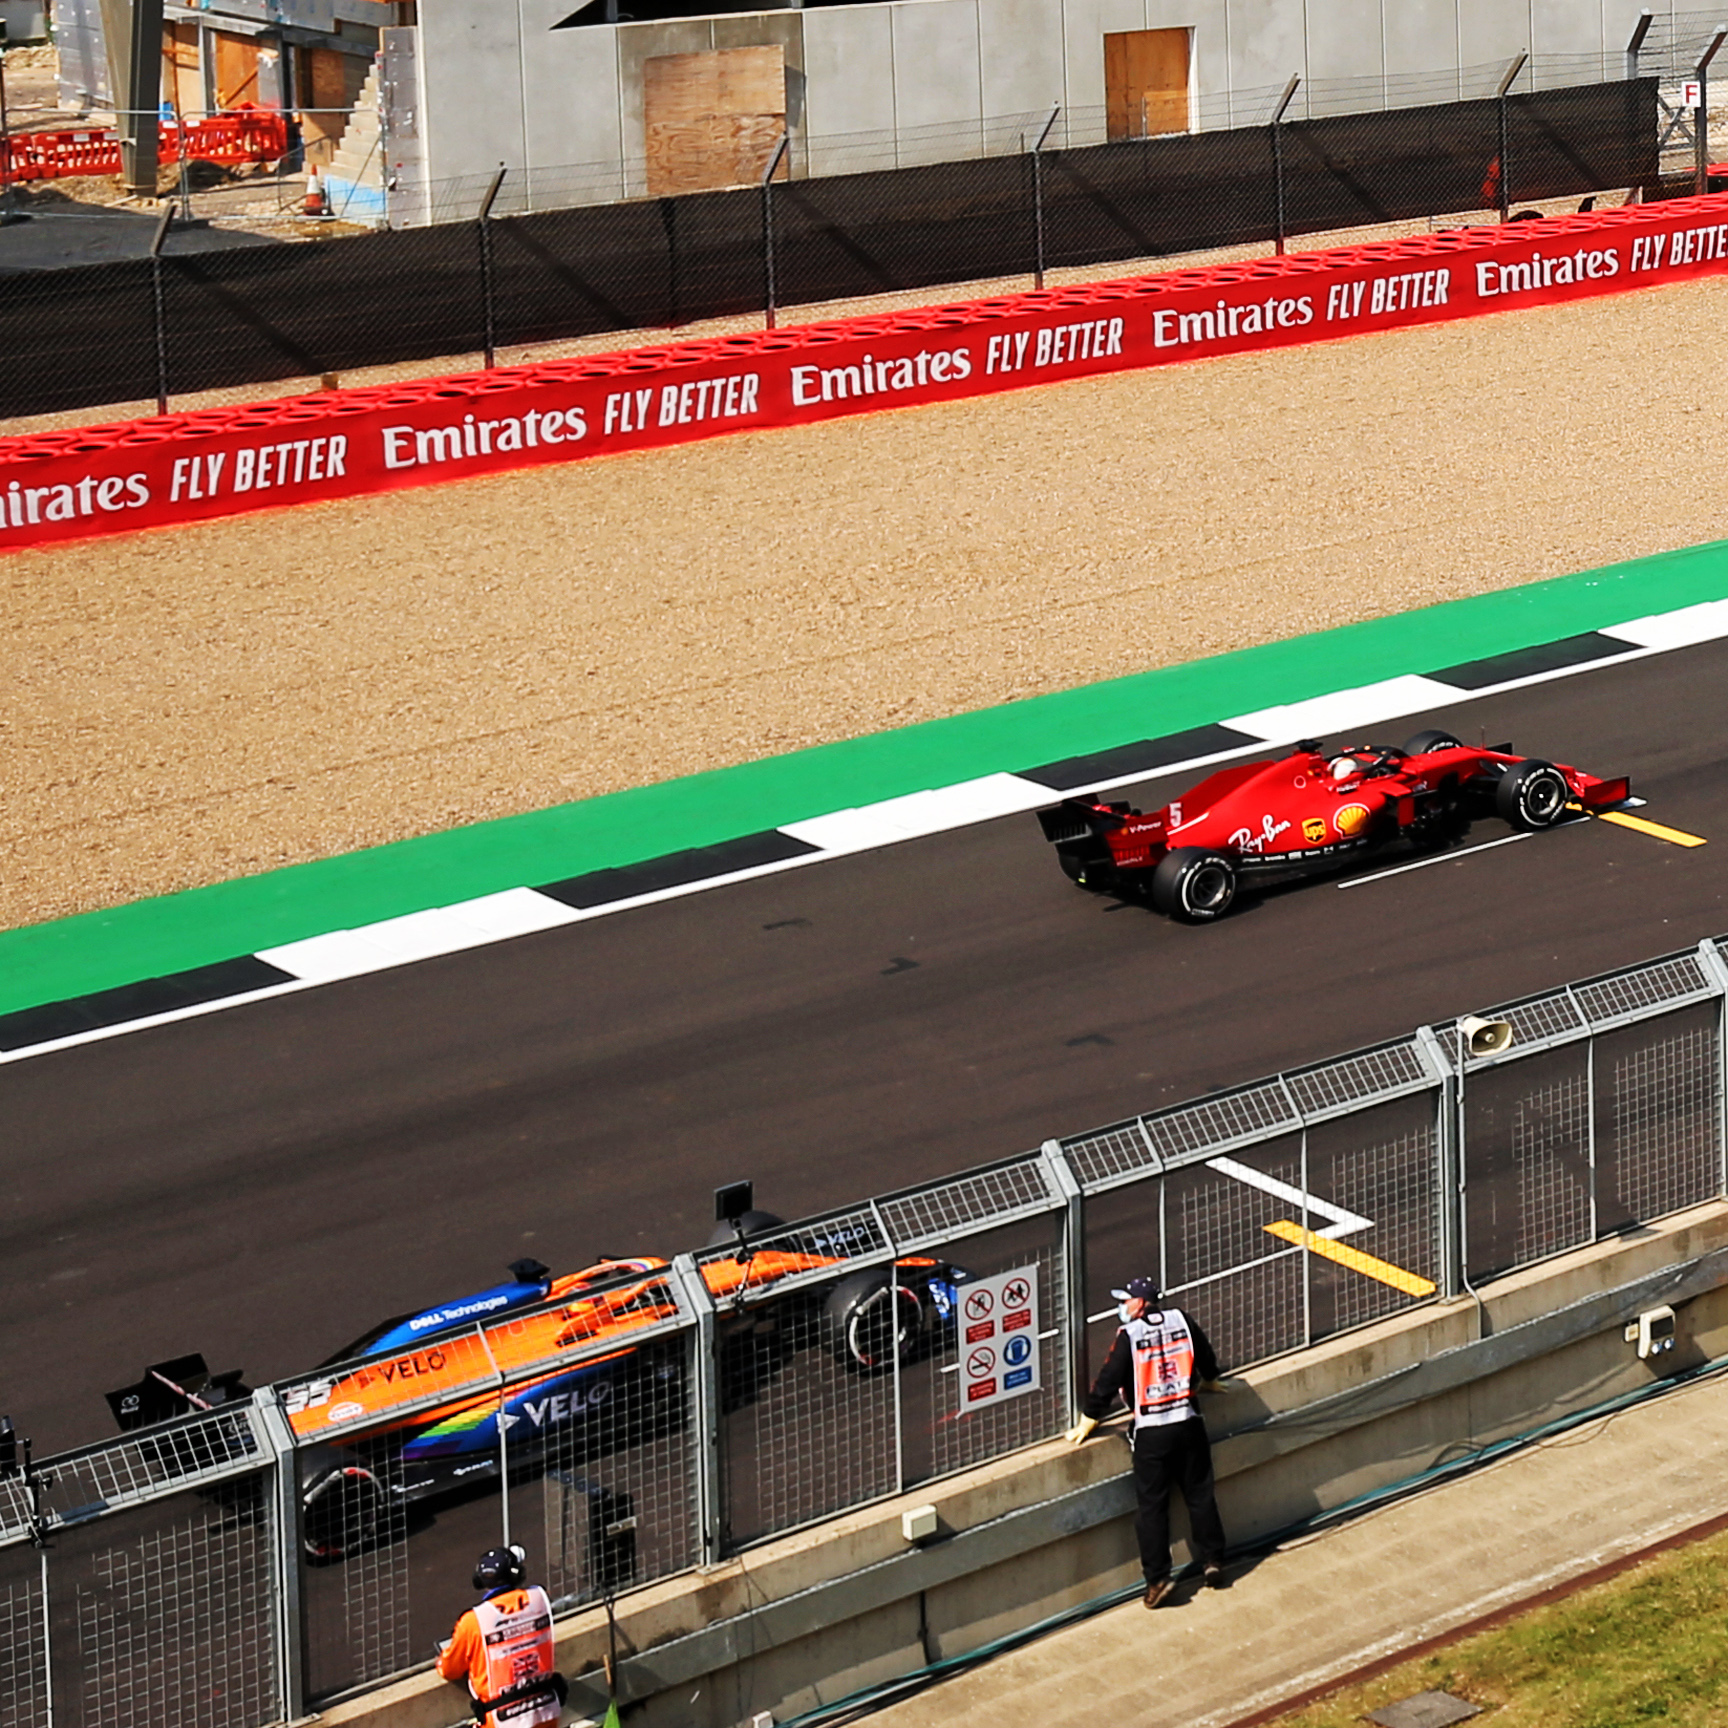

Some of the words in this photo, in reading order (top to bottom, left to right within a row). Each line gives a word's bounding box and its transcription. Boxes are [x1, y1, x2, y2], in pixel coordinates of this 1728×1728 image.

[1685, 85, 1698, 105] F
[1475, 248, 1619, 297] Emirates
[1631, 233, 1666, 272] FLY
[1153, 296, 1314, 351] Emirates
[1326, 280, 1366, 321] FLY
[1370, 268, 1450, 315] BETTER
[790, 346, 972, 406] Emirates
[986, 331, 1029, 375] FLY
[1034, 317, 1123, 367] BETTER
[382, 407, 587, 472] Emirates
[604, 388, 653, 435] FLY
[658, 373, 759, 427] BETTER
[170, 452, 226, 502] FLY
[233, 435, 347, 492] BETTER
[1169, 802, 1182, 827] 5
[443, 1295, 508, 1319] Technologies
[378, 1351, 446, 1385] VELO
[524, 1380, 611, 1427] VELO
